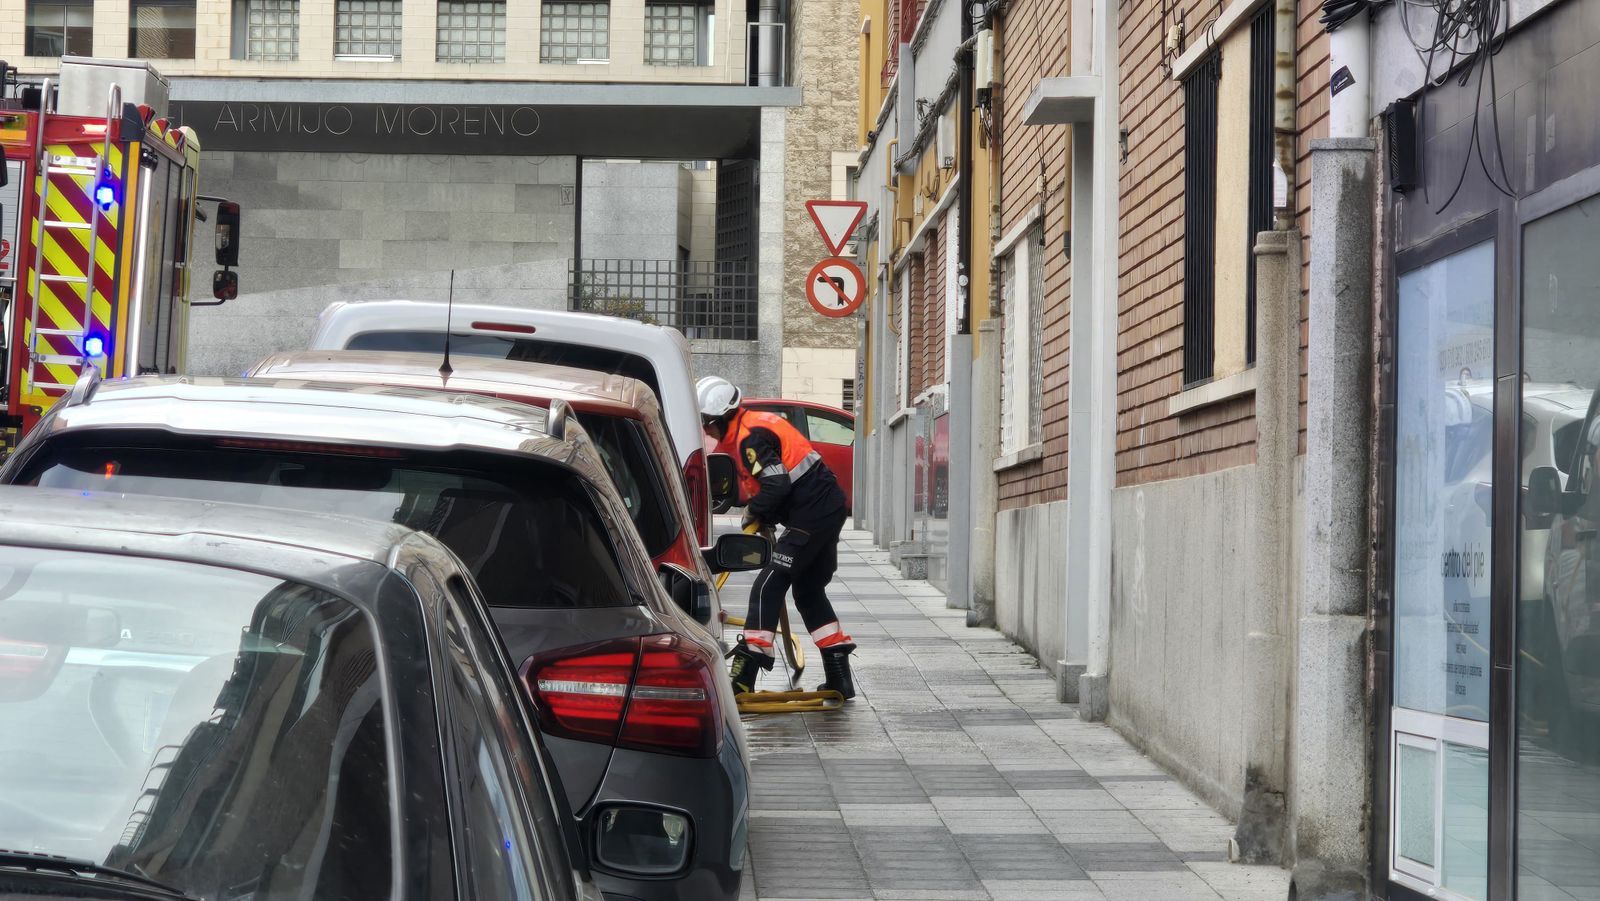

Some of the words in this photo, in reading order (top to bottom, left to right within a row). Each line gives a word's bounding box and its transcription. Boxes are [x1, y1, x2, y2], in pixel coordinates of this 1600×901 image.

[214, 103, 353, 135] ARMIJO
[375, 104, 541, 137] MORENO
[1462, 542, 1473, 578] del
[1474, 543, 1485, 587] pie
